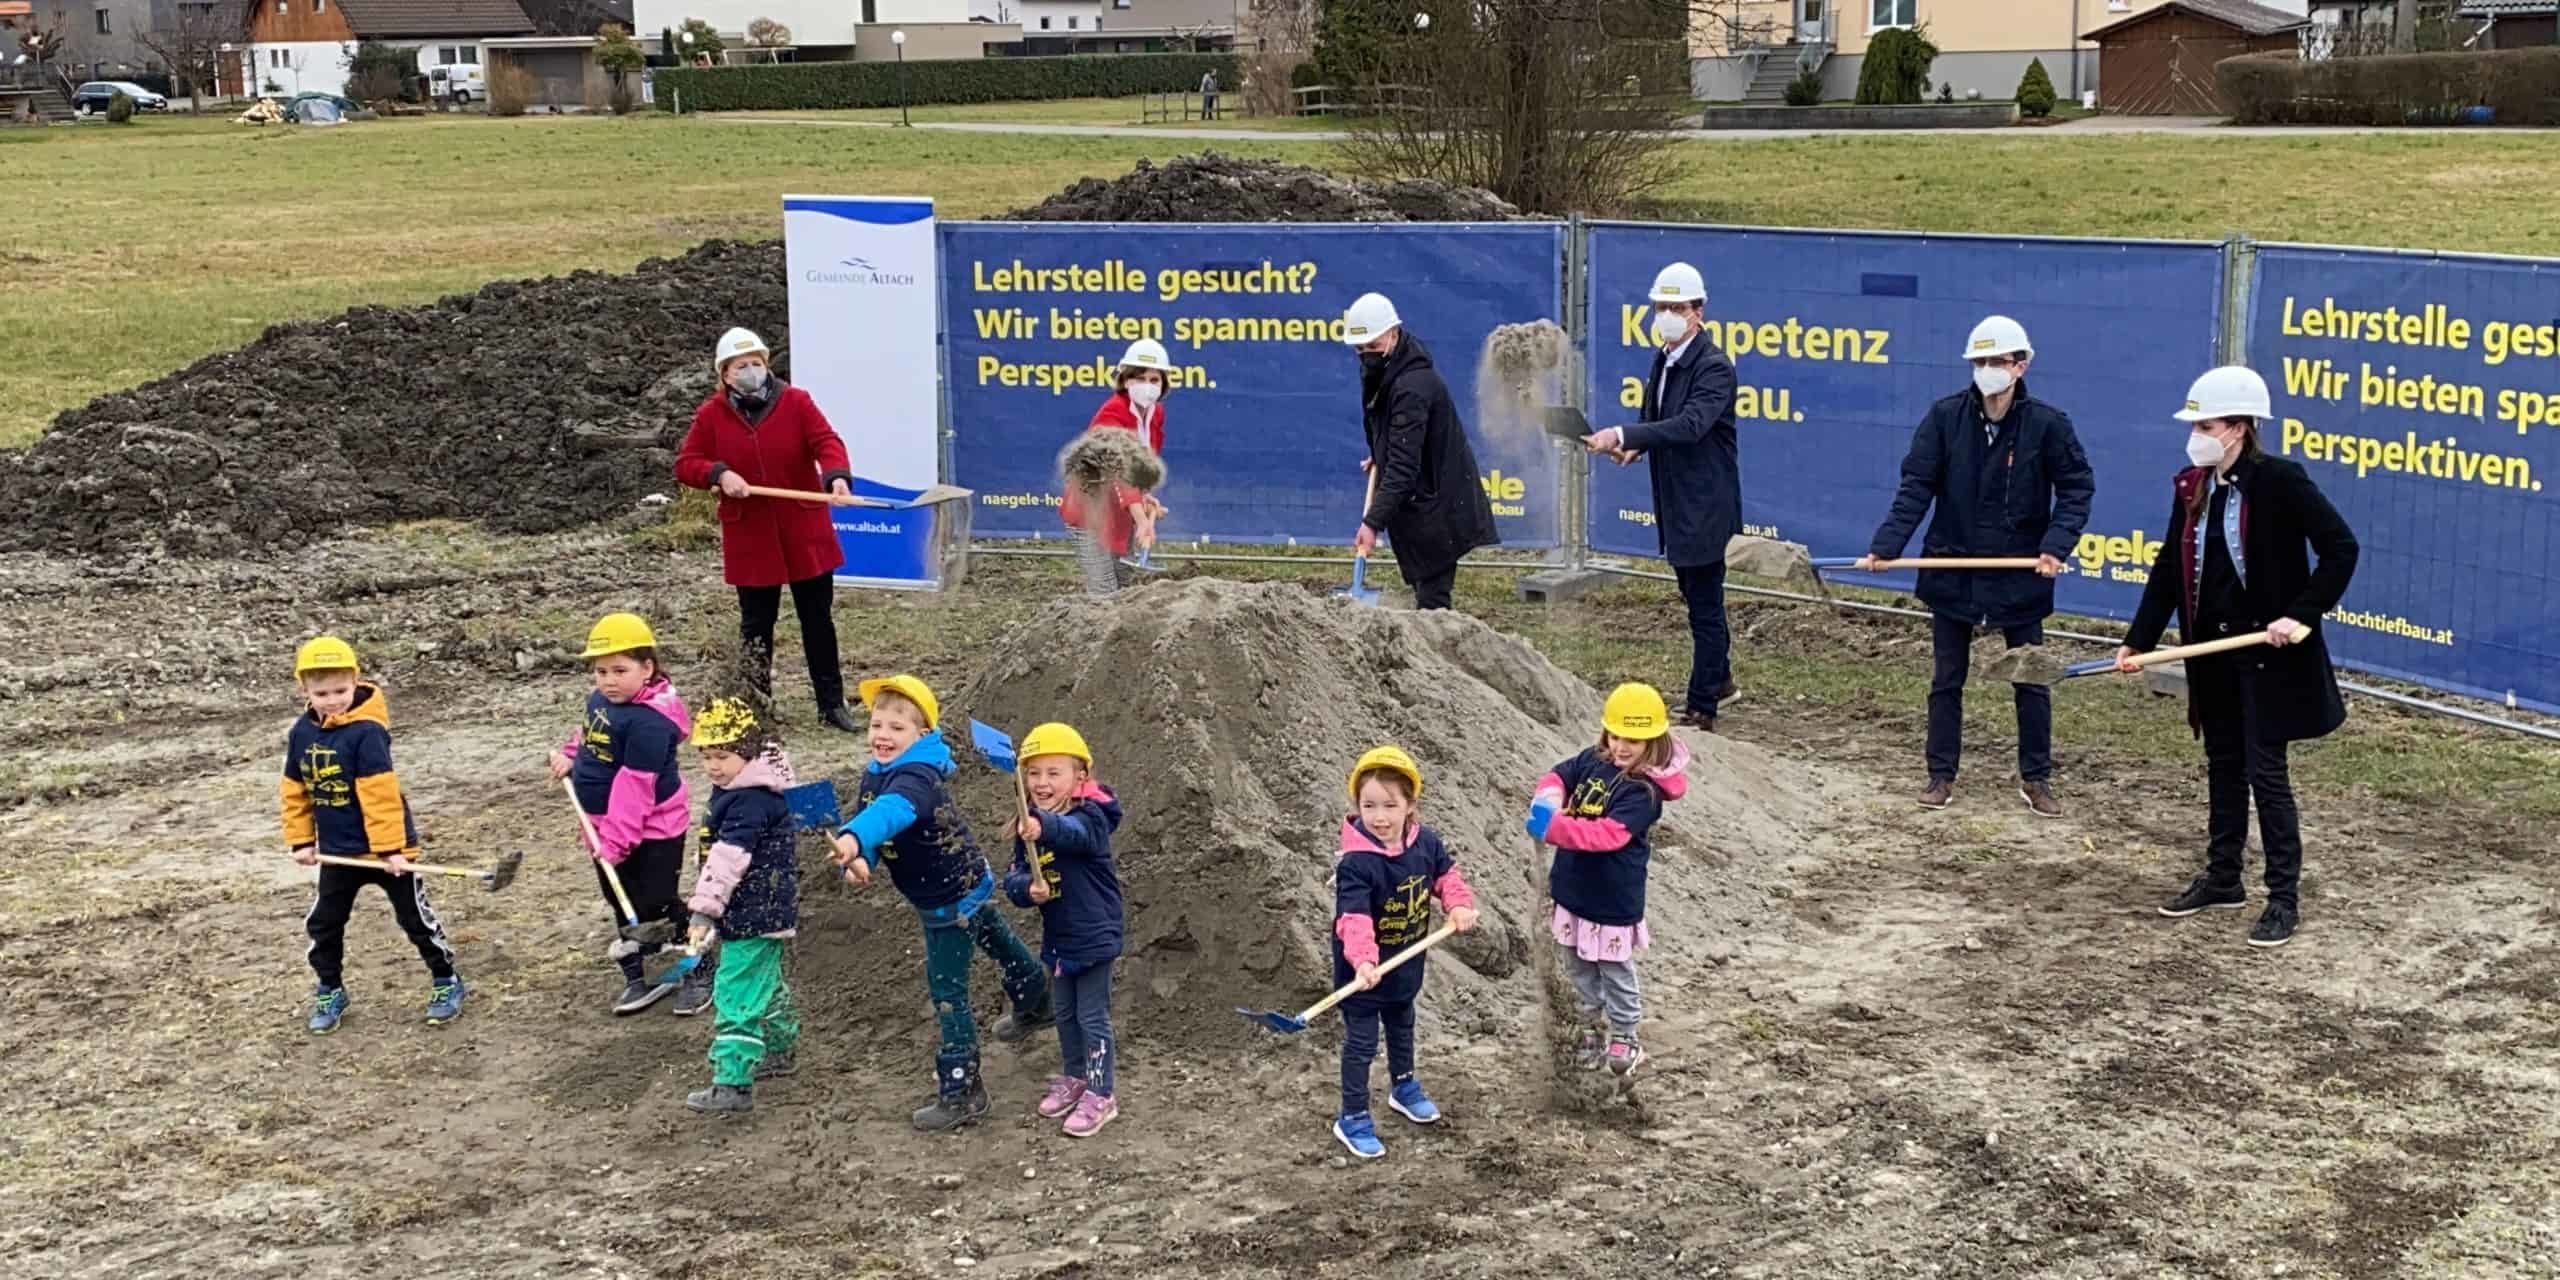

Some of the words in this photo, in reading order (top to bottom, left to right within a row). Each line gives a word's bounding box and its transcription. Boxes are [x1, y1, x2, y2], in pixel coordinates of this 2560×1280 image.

[973, 260, 1146, 292] Lehrstelle
[1157, 260, 1318, 301] gesucht?
[973, 308, 1040, 340] Wir
[1049, 308, 1163, 340] bieten
[1174, 310, 1350, 348] spannend
[2282, 296, 2471, 349] Lehrstelle
[2483, 320, 2560, 364] ges
[978, 356, 1217, 394] Perspeken.
[2282, 356, 2350, 400] Wir
[2360, 362, 2485, 417] bieten
[2496, 387, 2560, 434] spa
[1734, 384, 1805, 423] au.
[2281, 417, 2543, 491] Perspektiven.
[982, 492, 1064, 509] naegele-ho
